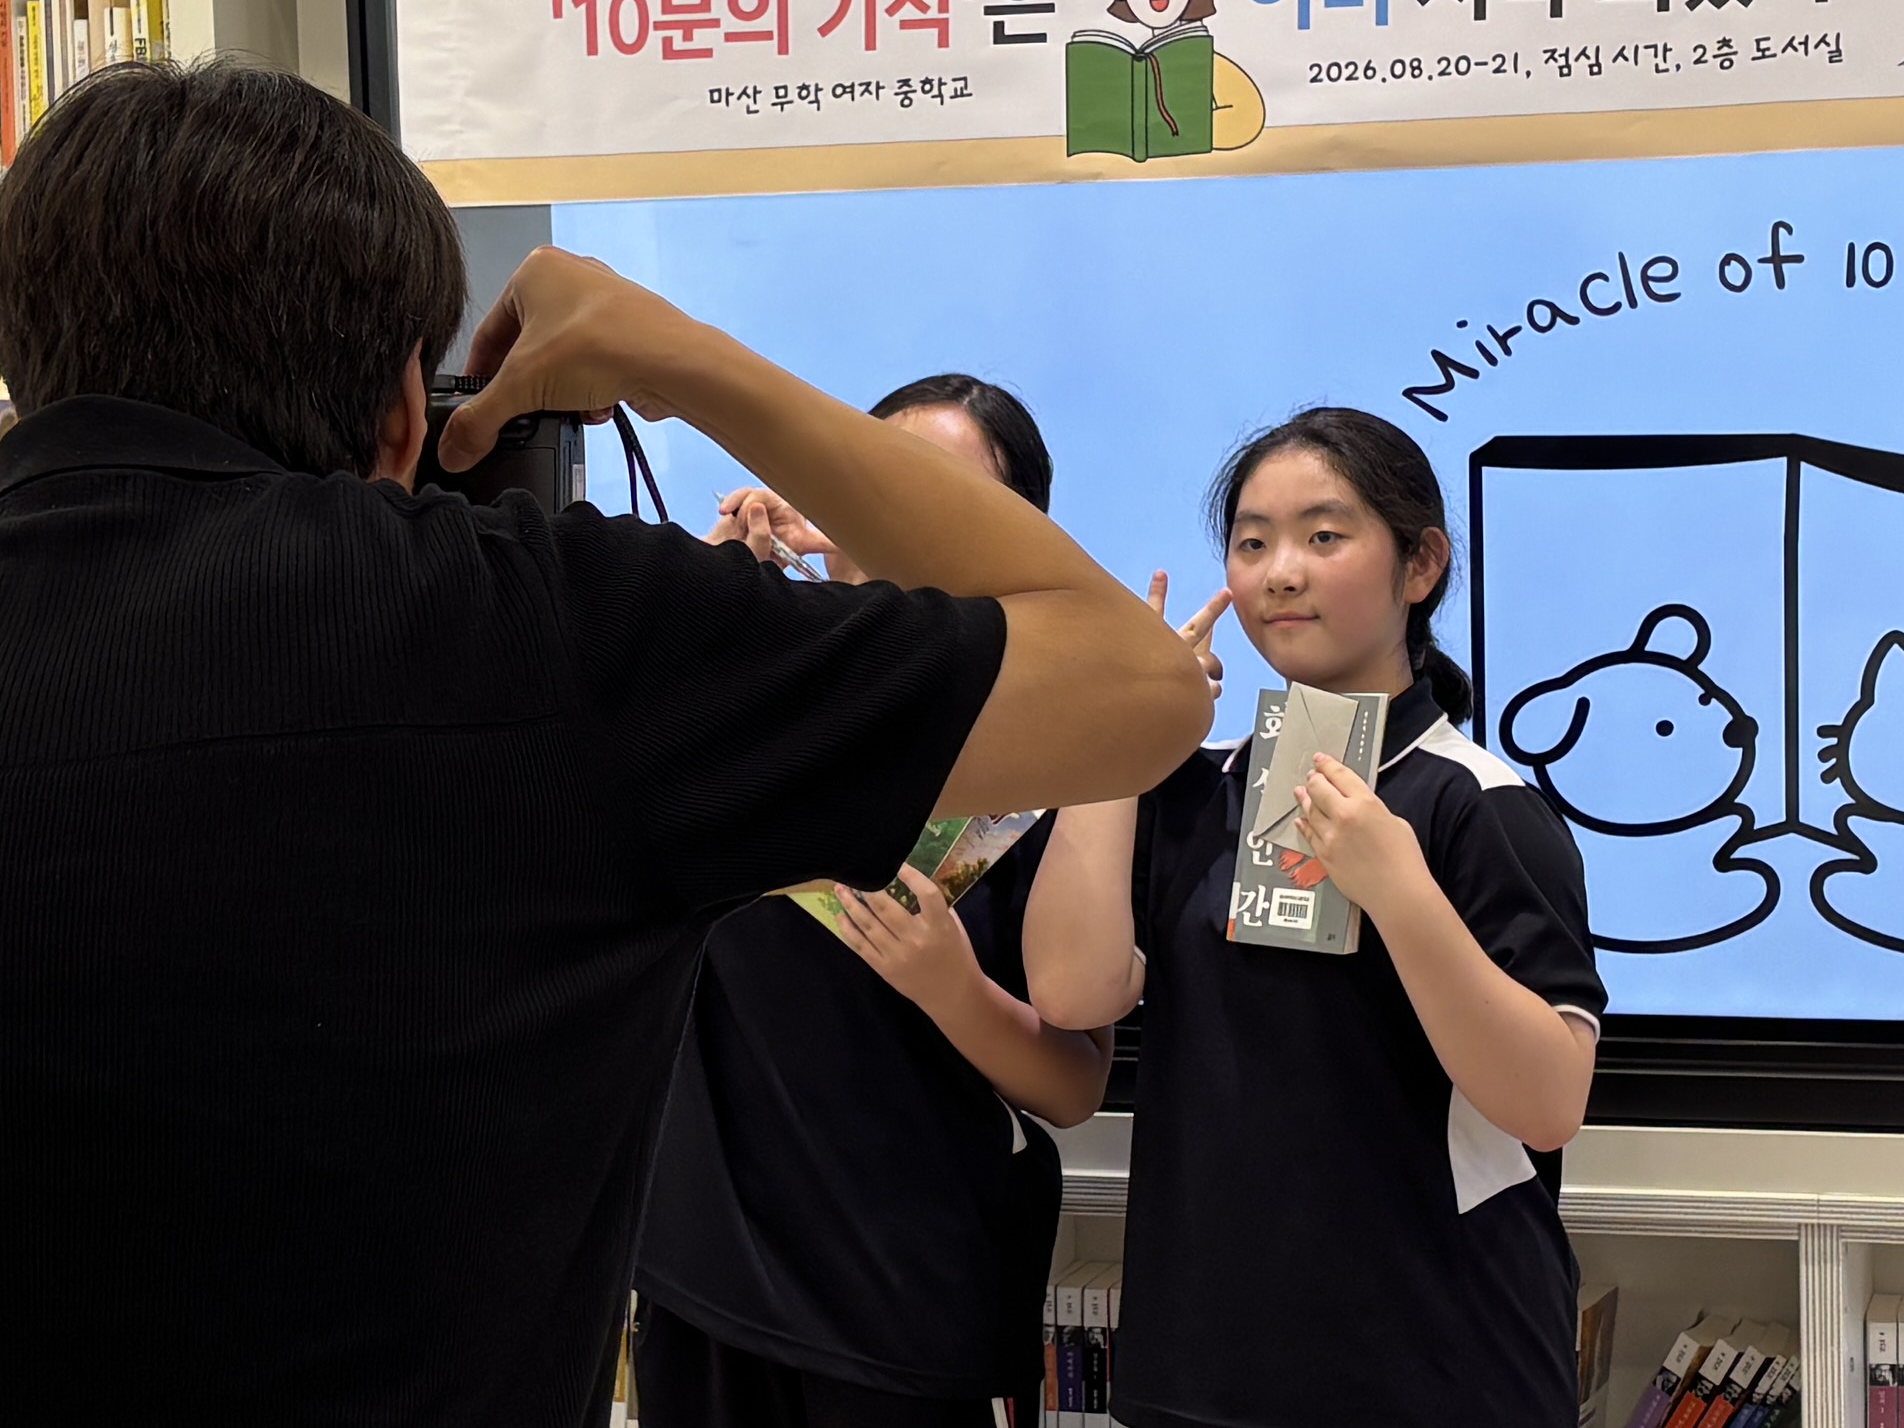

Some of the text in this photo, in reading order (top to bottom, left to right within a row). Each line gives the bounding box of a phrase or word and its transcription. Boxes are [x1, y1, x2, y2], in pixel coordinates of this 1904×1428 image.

[1308, 31, 1845, 85] 2026.08.20-21, 점심 시간, 2층 도서실
[708, 74, 974, 115] 마산 무학 여자 중학교
[1401, 248, 1682, 423] Miracle
[1718, 219, 1806, 293] of
[1845, 240, 1895, 290] 10
